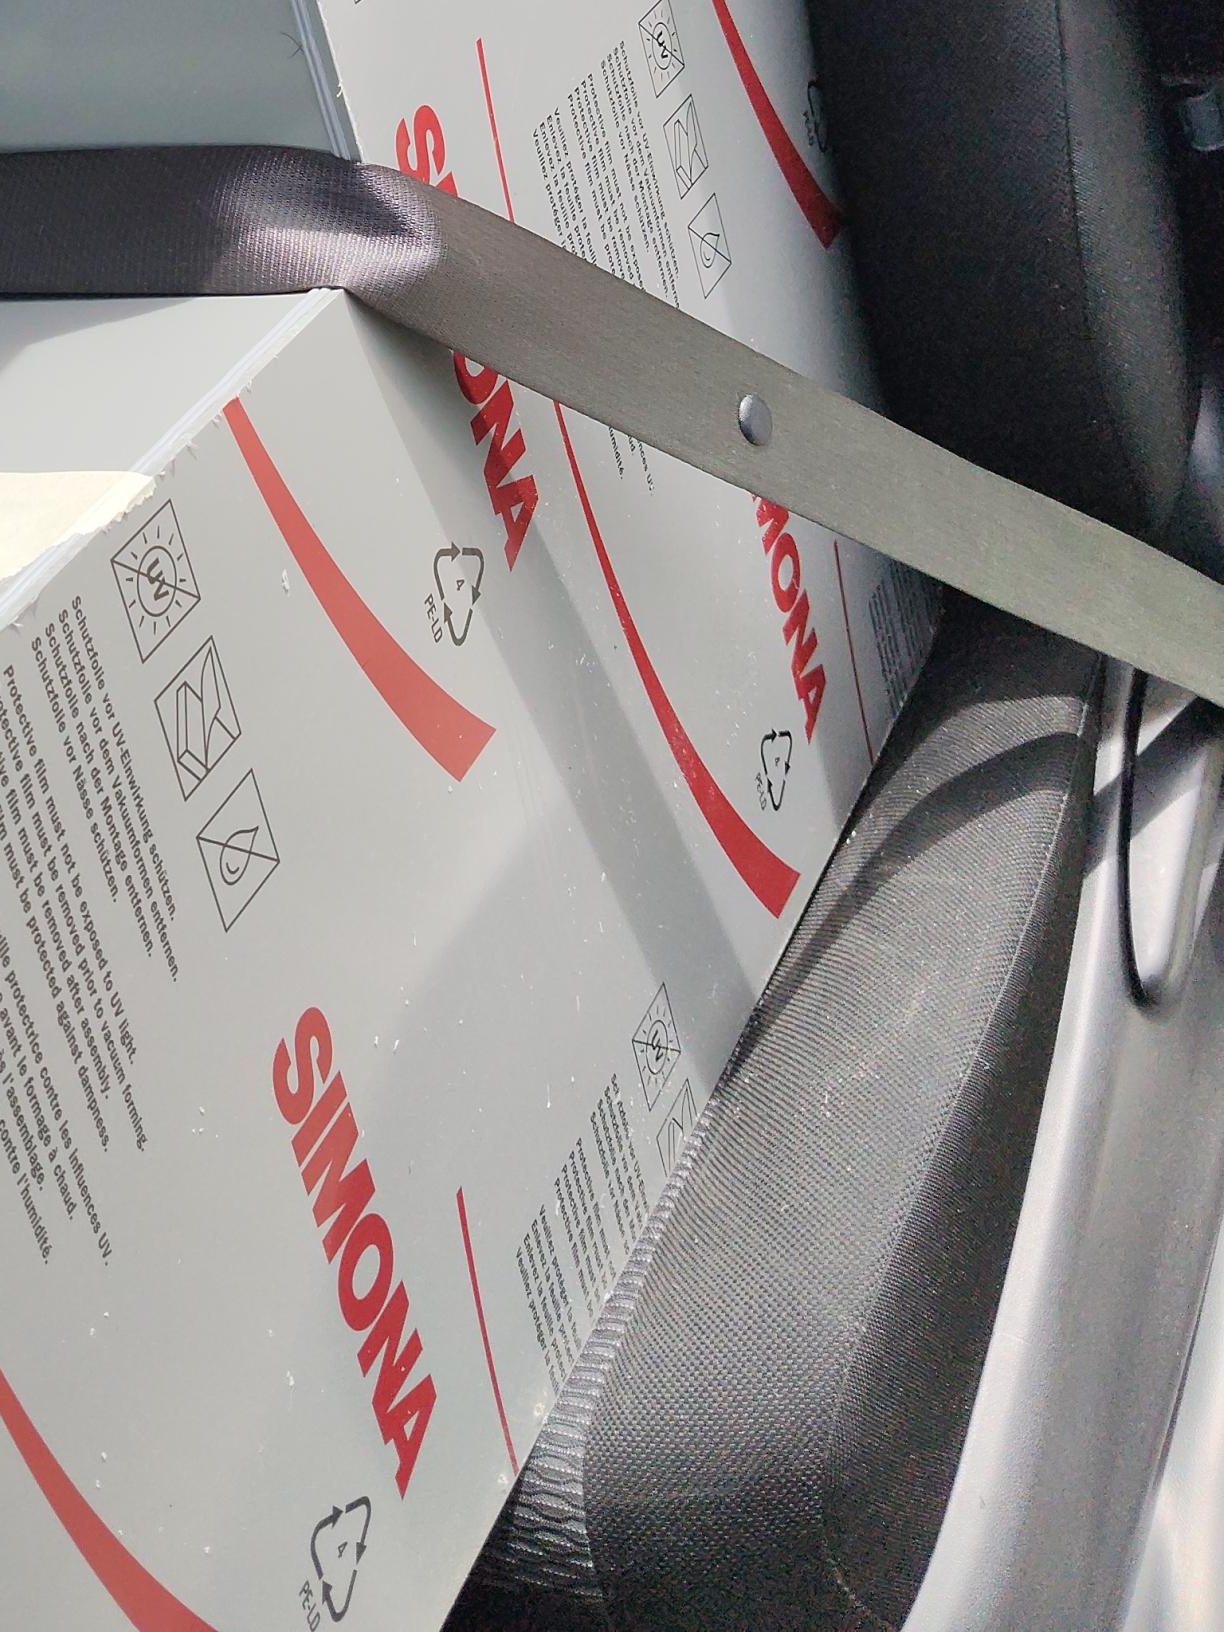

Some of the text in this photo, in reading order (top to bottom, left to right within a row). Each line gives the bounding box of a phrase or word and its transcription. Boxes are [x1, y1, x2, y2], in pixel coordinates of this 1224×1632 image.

[146, 557, 170, 602] UV
[423, 593, 443, 644] PE-LD
[30, 635, 119, 903] Schutzfolie vor Nässe schützen.
[43, 621, 154, 958] Schutzfolie nach der Montage entfernen.
[57, 607, 179, 983] Schutzfolie vor dem Vakuumformen entfernen.
[70, 594, 176, 922] Schutzfolie vor UV-Einwirkung schützen.
[1, 663, 137, 1065] Protective film must not be exposed to UV light.
[2, 840, 26, 890] must
[17, 886, 32, 914] be
[4, 787, 22, 826] film
[16, 825, 39, 874] must
[31, 870, 46, 898] be
[40, 898, 73, 974] removed
[65, 972, 86, 1016] after
[79, 1016, 112, 1100] assembly.
[18, 771, 36, 811] film
[30, 809, 53, 858] must
[45, 854, 59, 882] be
[53, 882, 86, 957] removed
[76, 956, 98, 998] prior
[92, 996, 104, 1020] to
[99, 1018, 126, 1086] vacuum
[120, 1082, 149, 1153] forming.
[24, 913, 63, 1000] protected
[15, 1053, 28, 1077] le
[54, 999, 84, 1065] against
[0, 1070, 45, 1192] l'assemblage.
[3, 968, 44, 1065] protectrice
[38, 1065, 63, 1122] contre
[57, 1118, 73, 1150] les
[67, 1146, 102, 1235] influences
[96, 1230, 113, 1267] UV.
[22, 1074, 52, 1148] formage
[76, 1063, 110, 1153] dampness.
[46, 1145, 59, 1164] à
[52, 1162, 78, 1221] chaud.
[15, 1171, 53, 1265] l'humidité.
[272, 1006, 437, 1500] SIMONA
